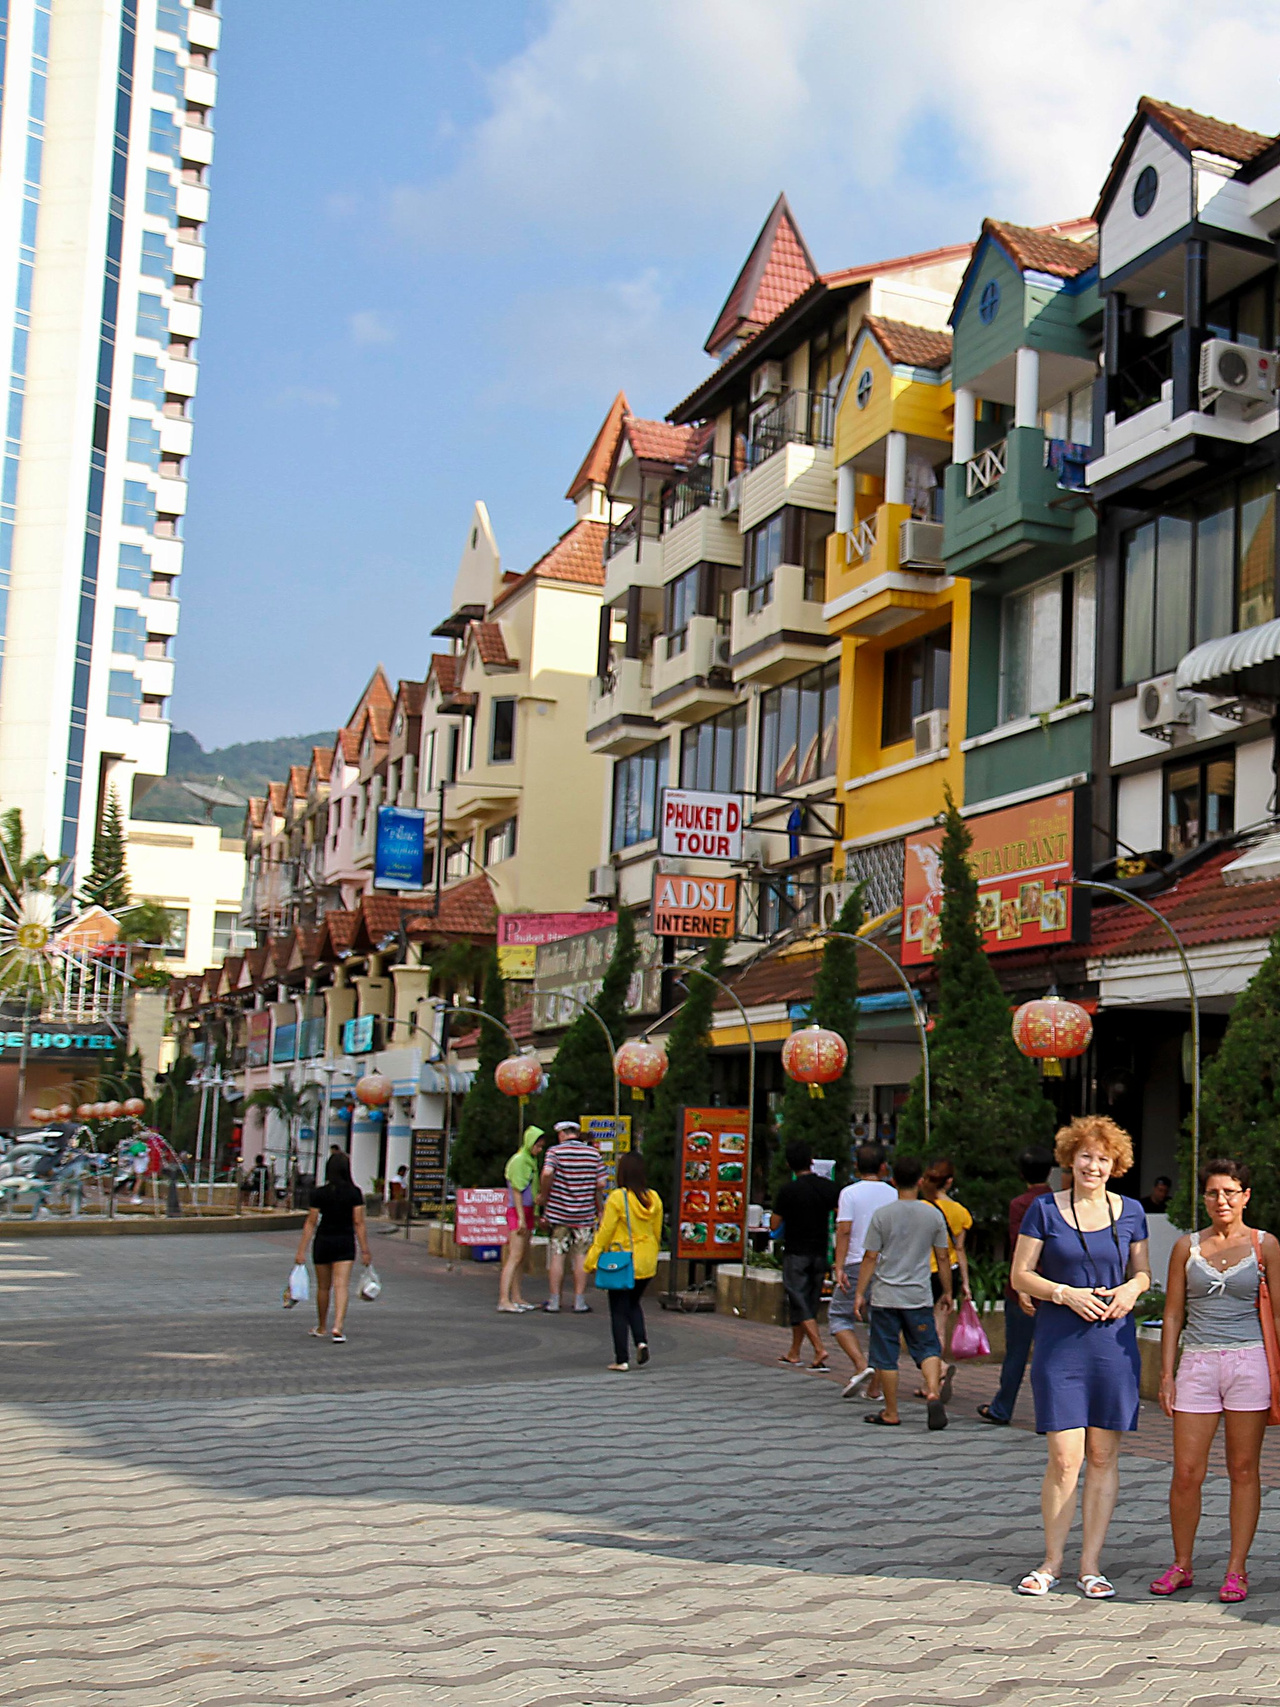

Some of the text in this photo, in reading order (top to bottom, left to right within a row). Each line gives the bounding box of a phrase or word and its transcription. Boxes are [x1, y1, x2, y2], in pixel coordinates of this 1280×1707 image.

[666, 802, 740, 833] PHUKET D
[675, 832, 730, 856] TOUR
[959, 832, 1069, 880] STAURANT
[657, 879, 733, 912] ADSL
[656, 913, 730, 935] INTERNET
[30, 1032, 117, 1050] HOTEL
[464, 1191, 505, 1204] LAUNDRY
